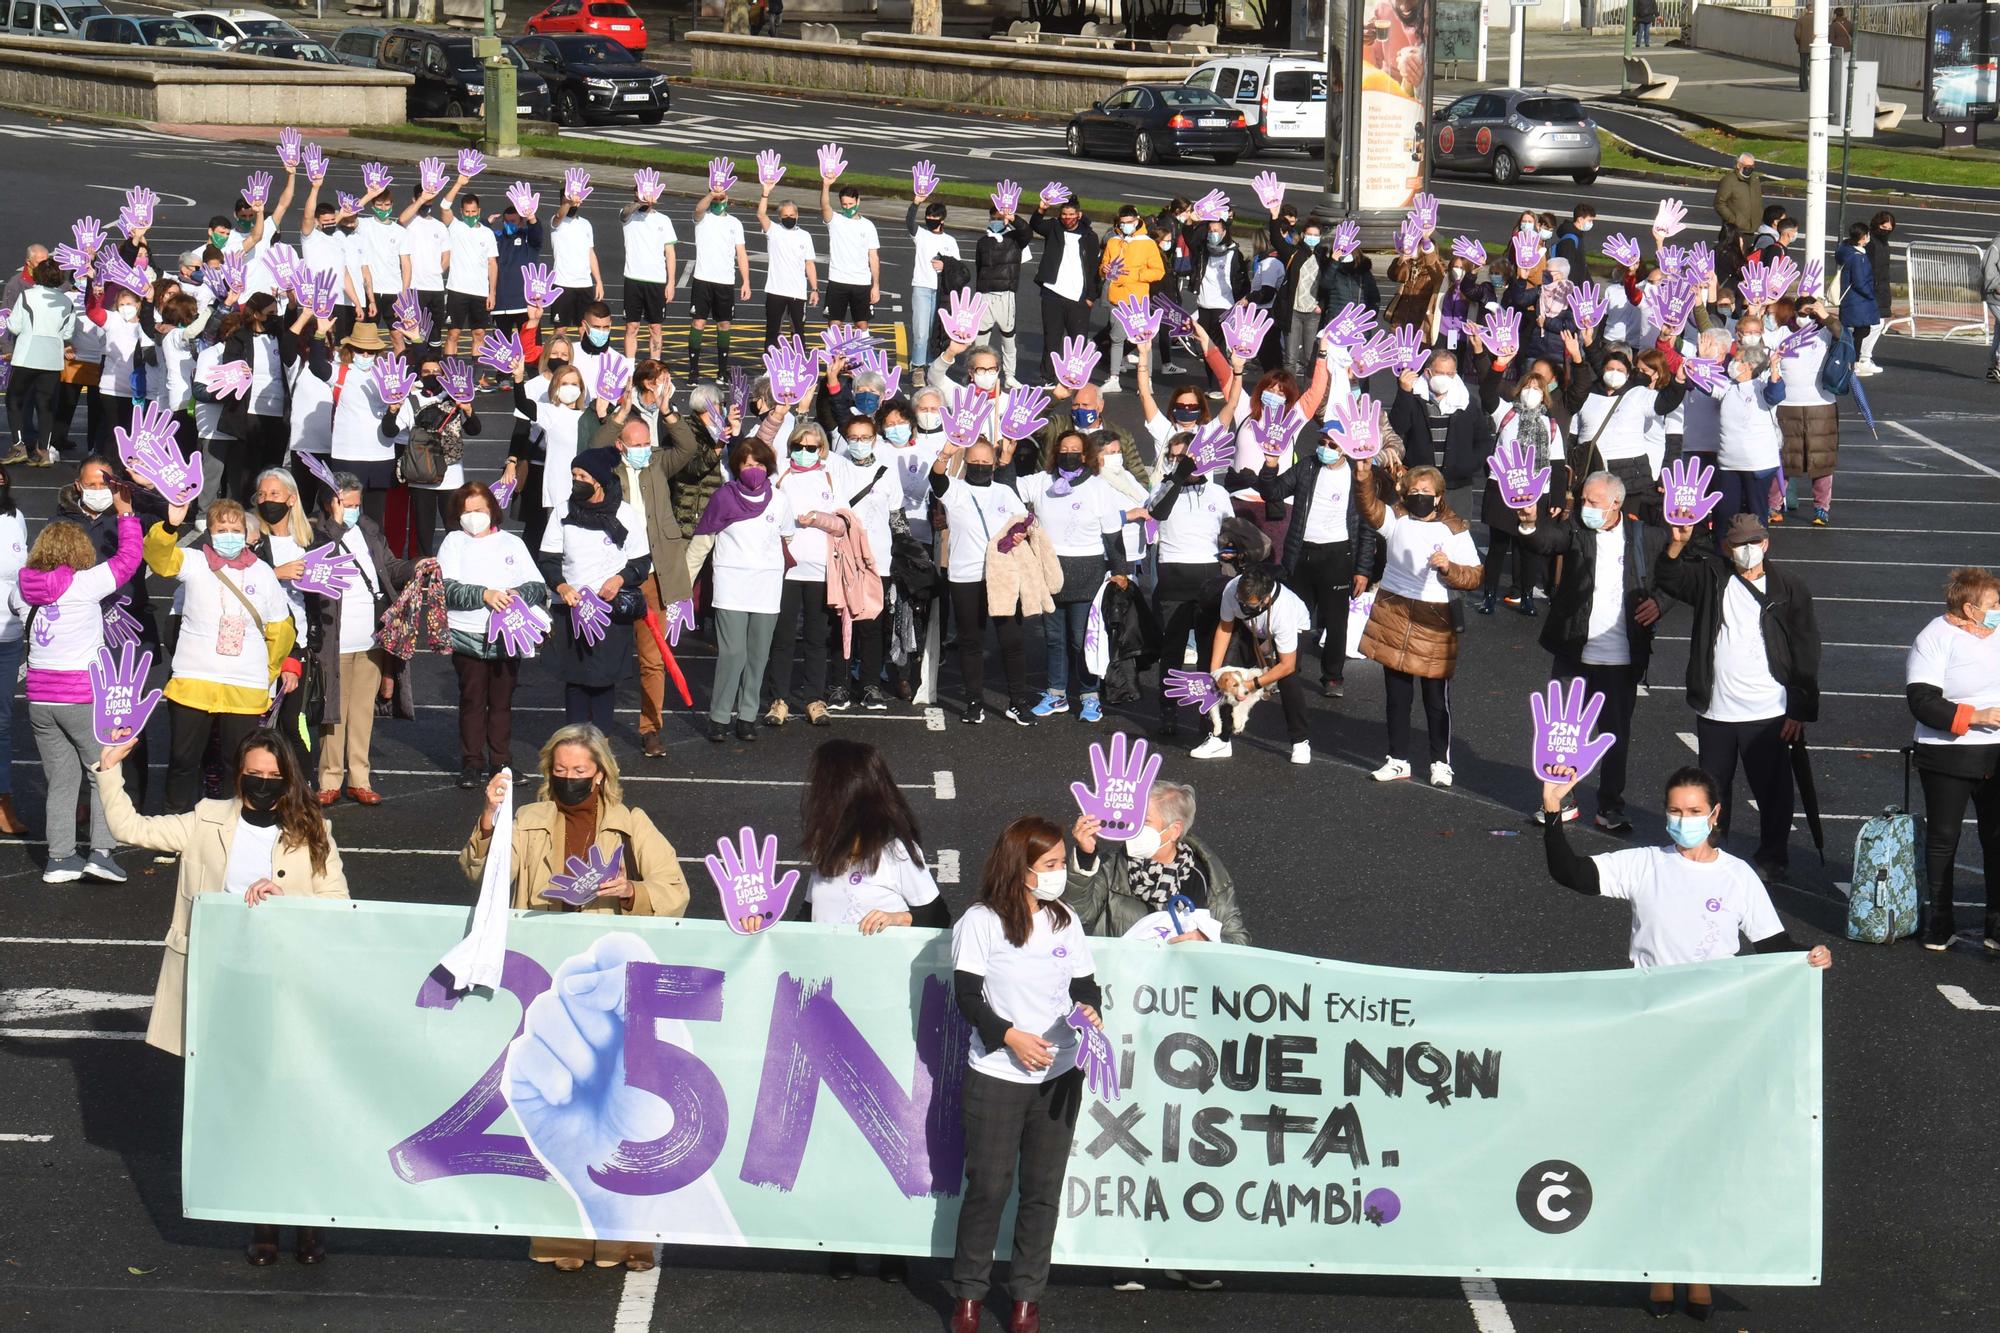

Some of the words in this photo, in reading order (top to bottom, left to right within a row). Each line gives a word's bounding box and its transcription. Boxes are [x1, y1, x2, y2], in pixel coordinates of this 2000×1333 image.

[104, 686, 134, 700] 25N
[1547, 721, 1581, 737] 25N
[1104, 777, 1137, 794] 25N
[733, 871, 764, 892] 25N
[1133, 984, 1198, 1020] QUE
[1212, 983, 1312, 1024] NON
[1153, 1032, 1323, 1096] QUE
[1343, 1038, 1503, 1109] NON
[1069, 1100, 1400, 1171] XISTA.
[1183, 1181, 1224, 1223] O
